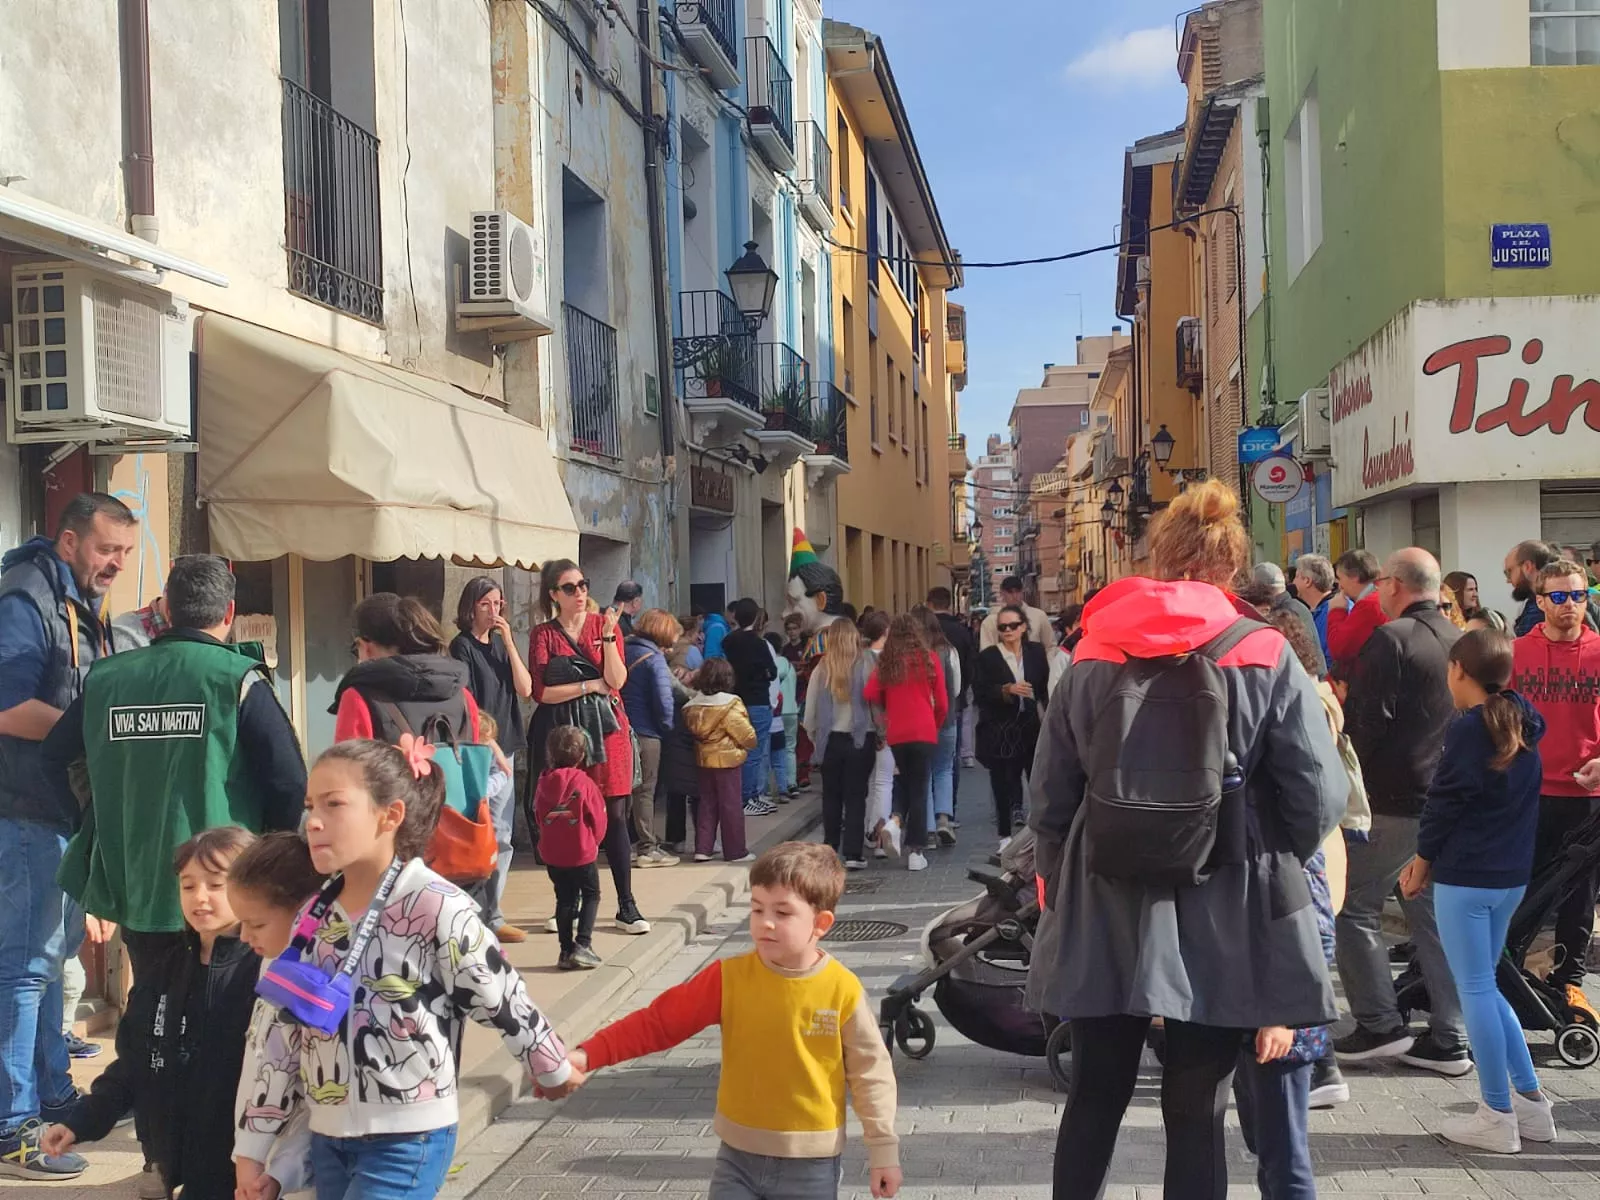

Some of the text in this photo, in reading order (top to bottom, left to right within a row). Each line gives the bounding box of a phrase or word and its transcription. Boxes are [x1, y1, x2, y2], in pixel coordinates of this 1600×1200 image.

[1502, 230, 1540, 238] PLAZA
[1493, 247, 1550, 263] JUSTICIA
[1422, 334, 1600, 437] Tin
[1242, 442, 1278, 452] DIG
[114, 711, 201, 733] VIVA SAN MARTIN
[343, 937, 366, 974] PURSE
[360, 909, 380, 938] PETS
[375, 869, 398, 901] PURSE
